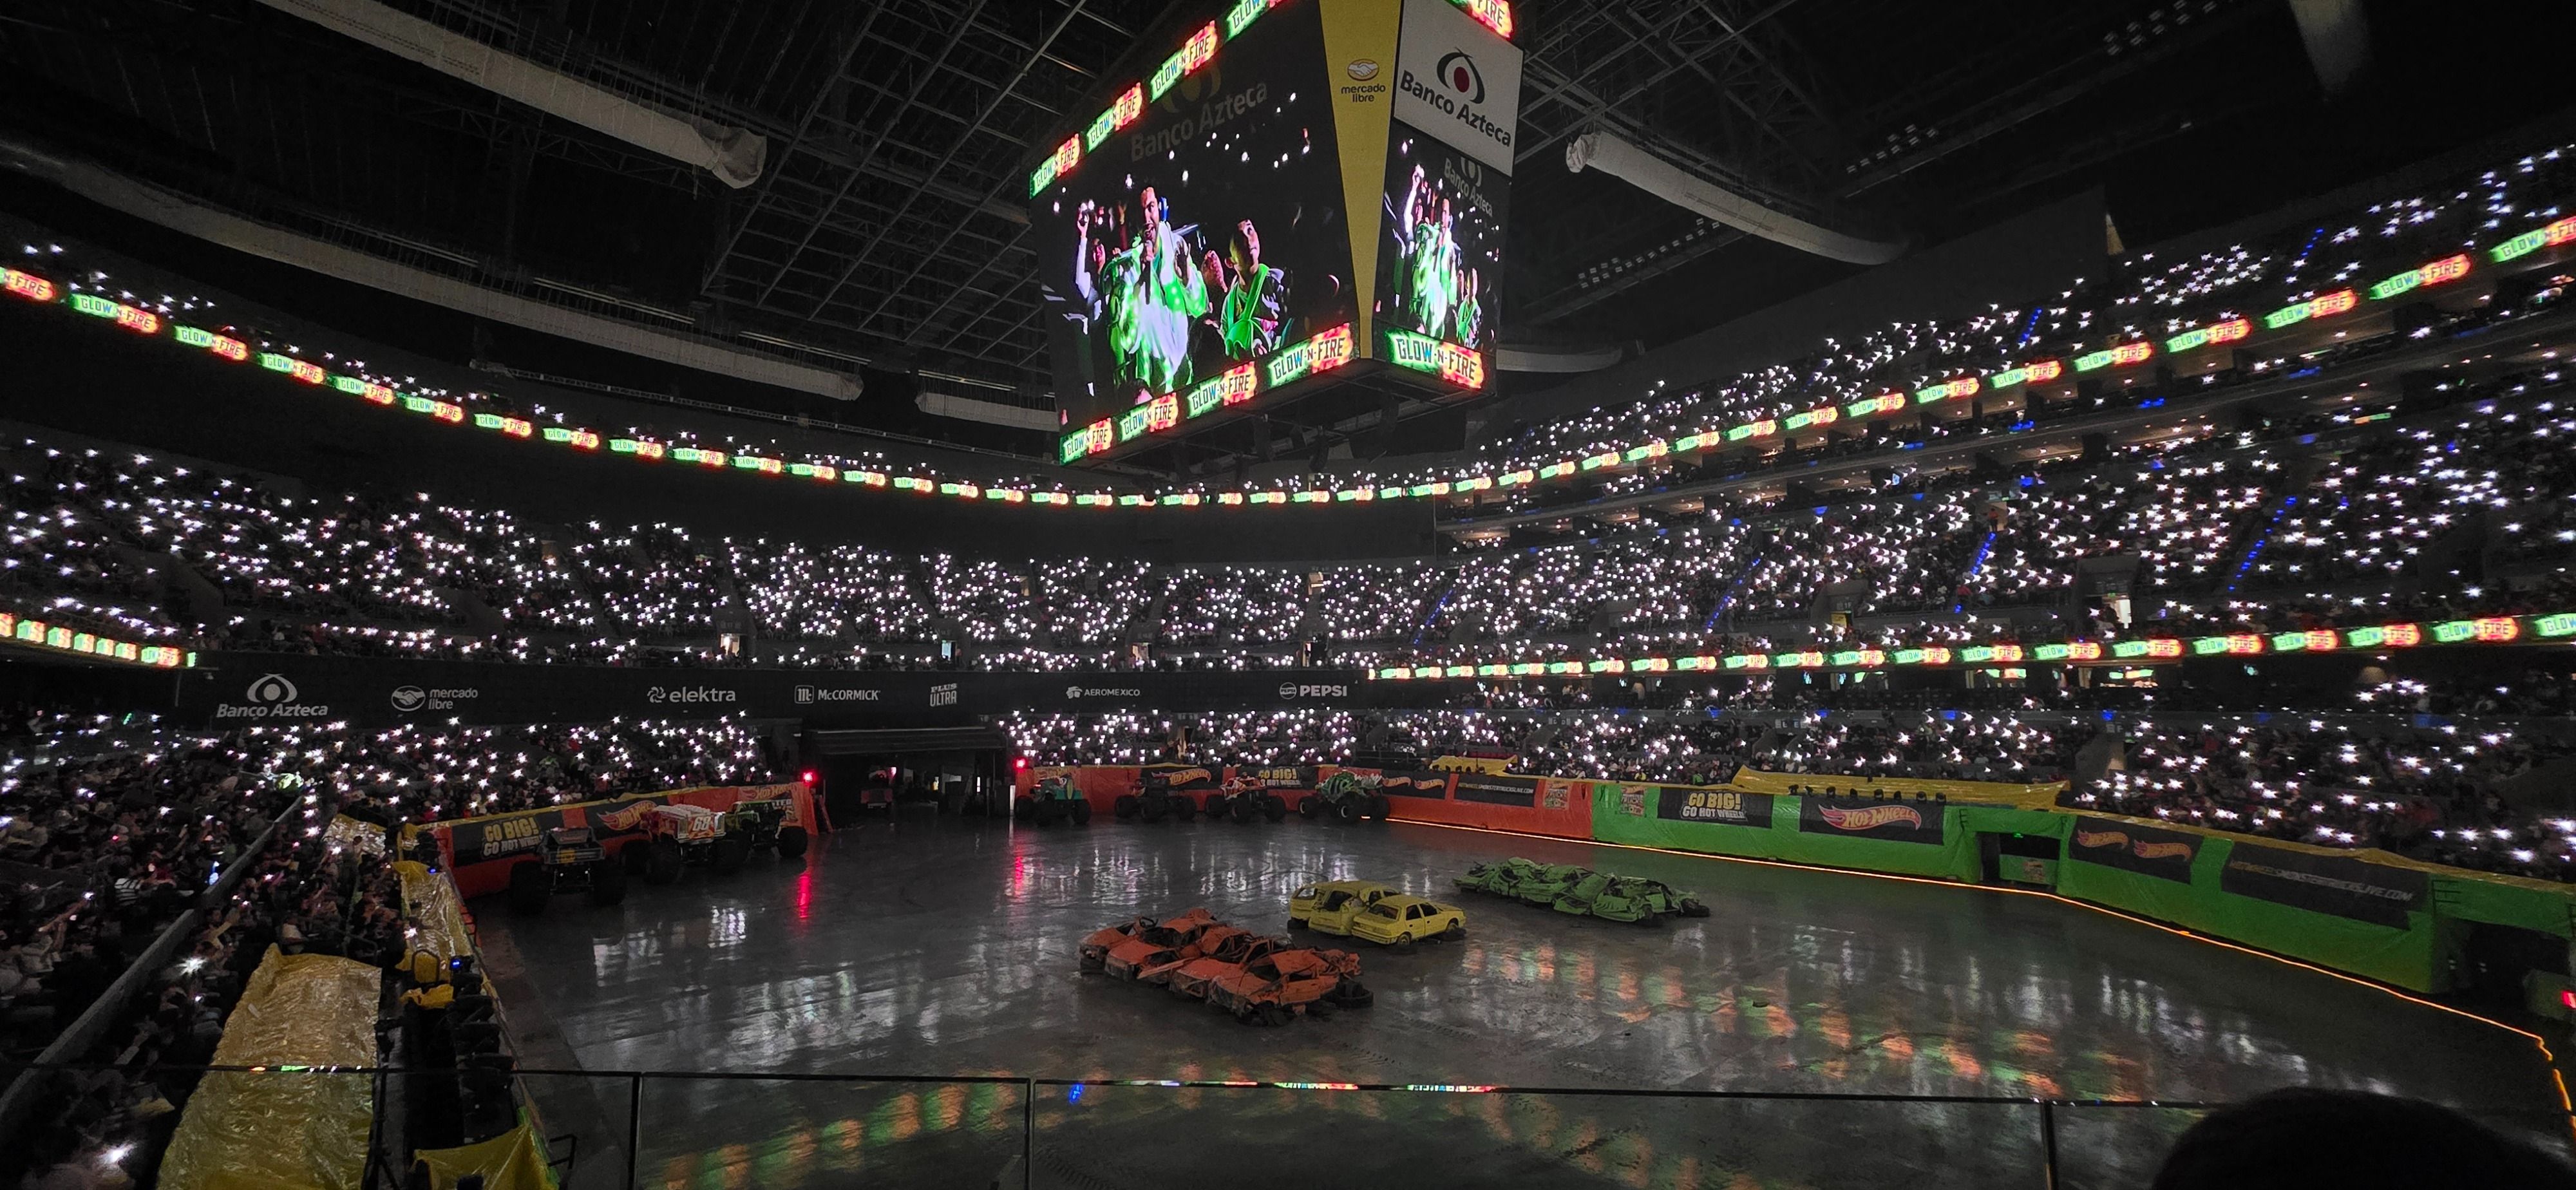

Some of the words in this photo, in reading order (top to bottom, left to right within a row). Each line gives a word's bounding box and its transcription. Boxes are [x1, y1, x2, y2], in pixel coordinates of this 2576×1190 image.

[1341, 83, 1386, 95] mercado
[1352, 93, 1375, 103] libre
[1400, 70, 1454, 115] Banco
[1457, 104, 1511, 147] Azteca
[1132, 116, 1191, 162] Banco
[1197, 83, 1268, 135] Azteca
[1444, 158, 1469, 197] Banco
[430, 688, 478, 699] mercado
[669, 685, 736, 703] elektra
[931, 683, 957, 693] PLUS
[1084, 688, 1141, 697] AEROMEXICO
[1300, 685, 1347, 697] PEPSI
[428, 698, 453, 710] libre
[929, 690, 957, 707] ULTRA
[216, 703, 267, 719] Banco
[270, 703, 329, 717] Azteca
[1689, 793, 1705, 807] GO
[1707, 793, 1741, 810] BIG!
[1682, 806, 1698, 817] GO
[1699, 808, 1716, 817] HOT
[1841, 811, 1871, 827] HOT
[484, 823, 503, 842] GO
[503, 817, 540, 840] BIG!
[692, 816, 710, 831] 68
[483, 841, 500, 857] GO
[501, 838, 519, 853] HOT
